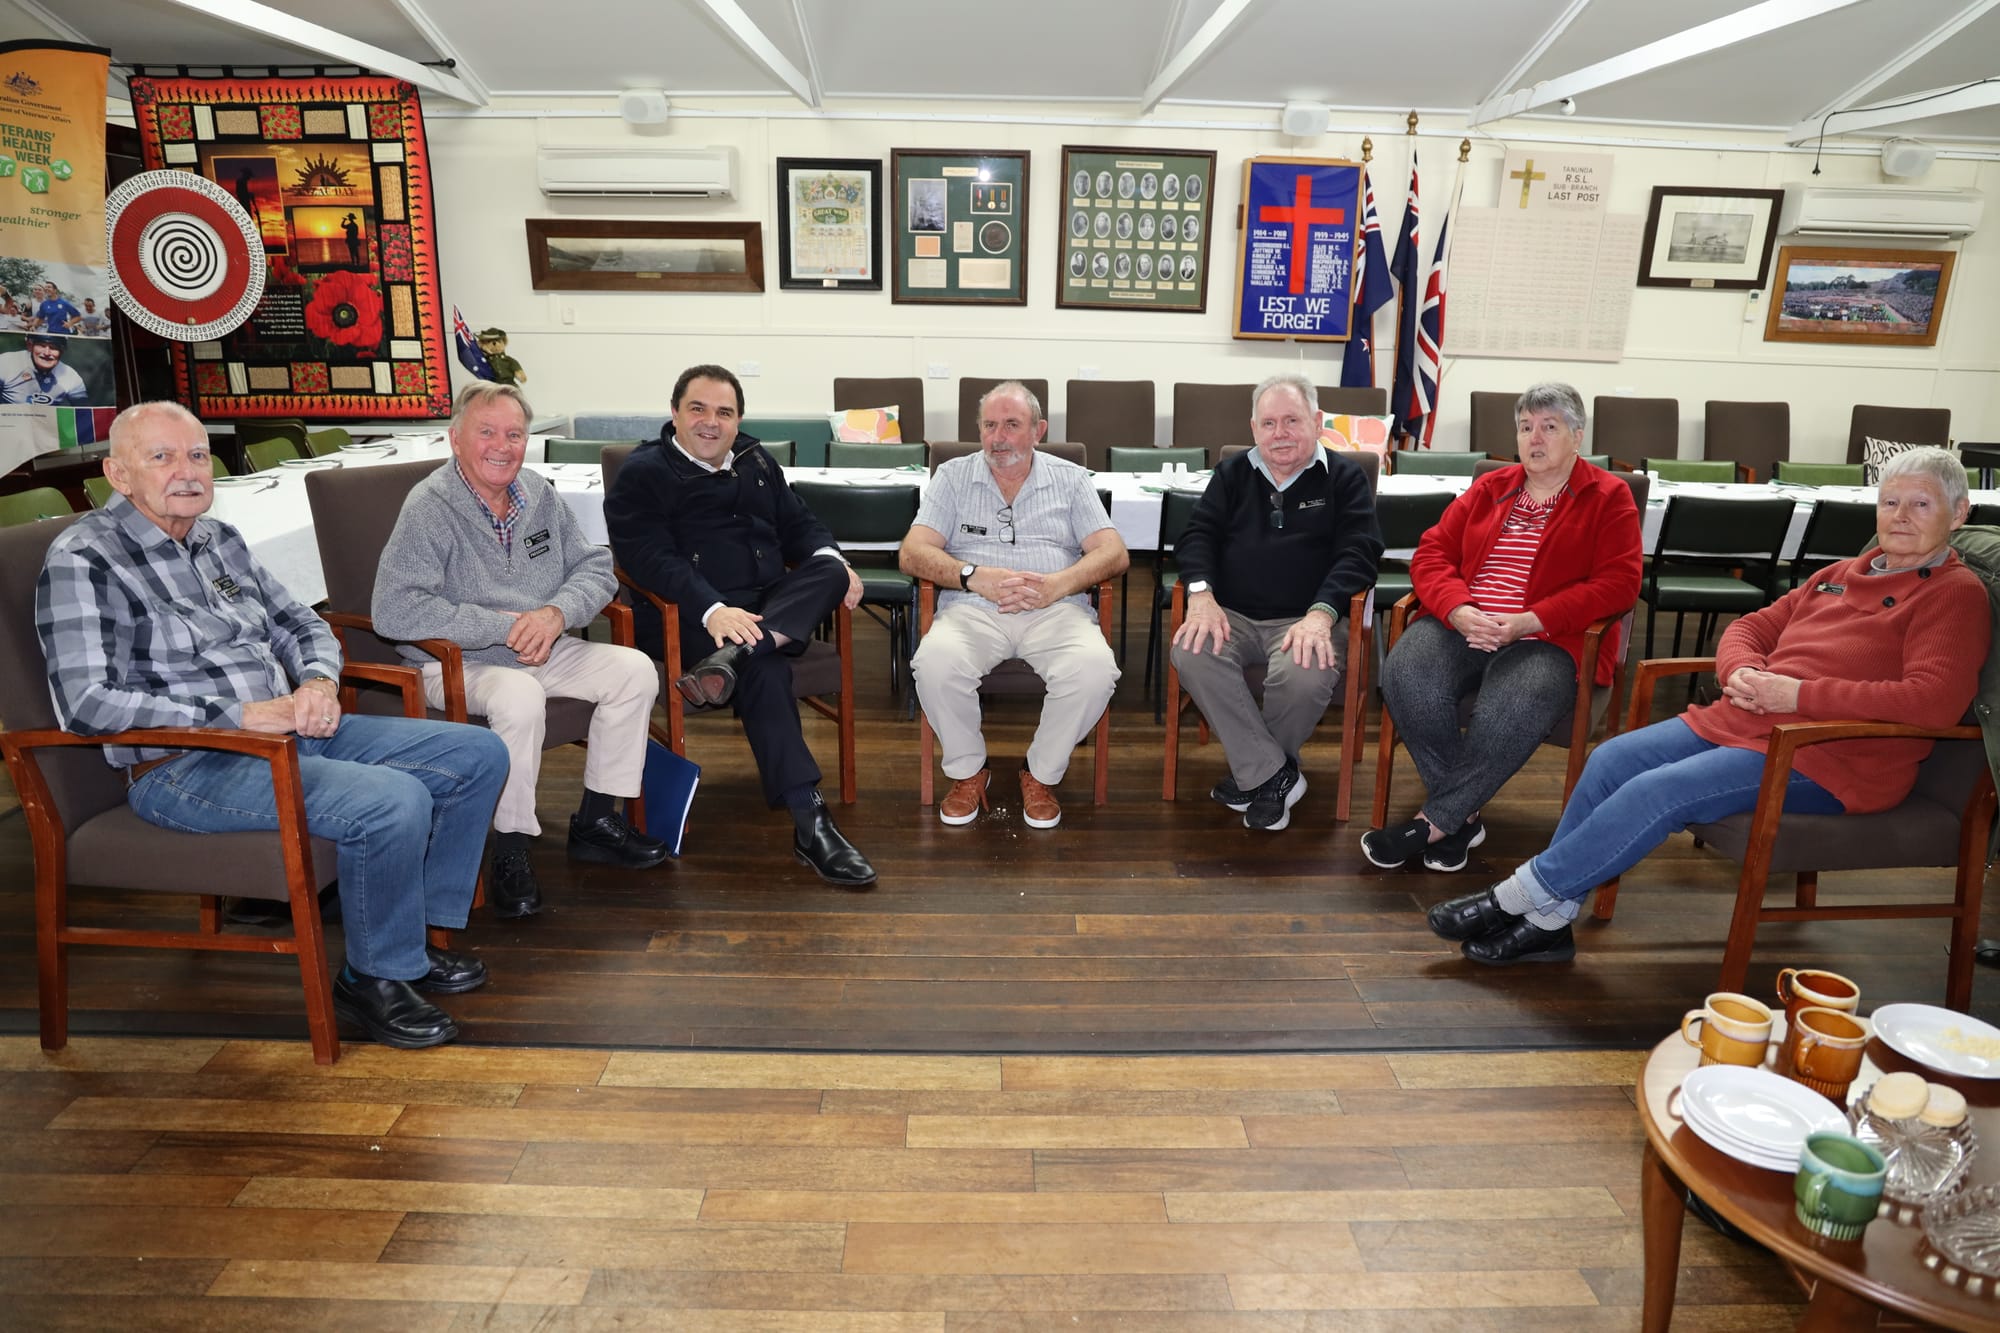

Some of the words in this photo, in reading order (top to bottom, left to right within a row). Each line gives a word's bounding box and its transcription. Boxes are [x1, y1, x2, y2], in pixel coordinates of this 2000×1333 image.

[3, 136, 51, 154] HEALTH
[15, 150, 51, 166] WEEK
[1547, 191, 1571, 201] LAST
[1577, 192, 1600, 202] POST
[30, 207, 81, 222] stronger
[1259, 296, 1297, 312] LEST
[1305, 297, 1331, 314] WE
[1263, 312, 1325, 330] FORGET
